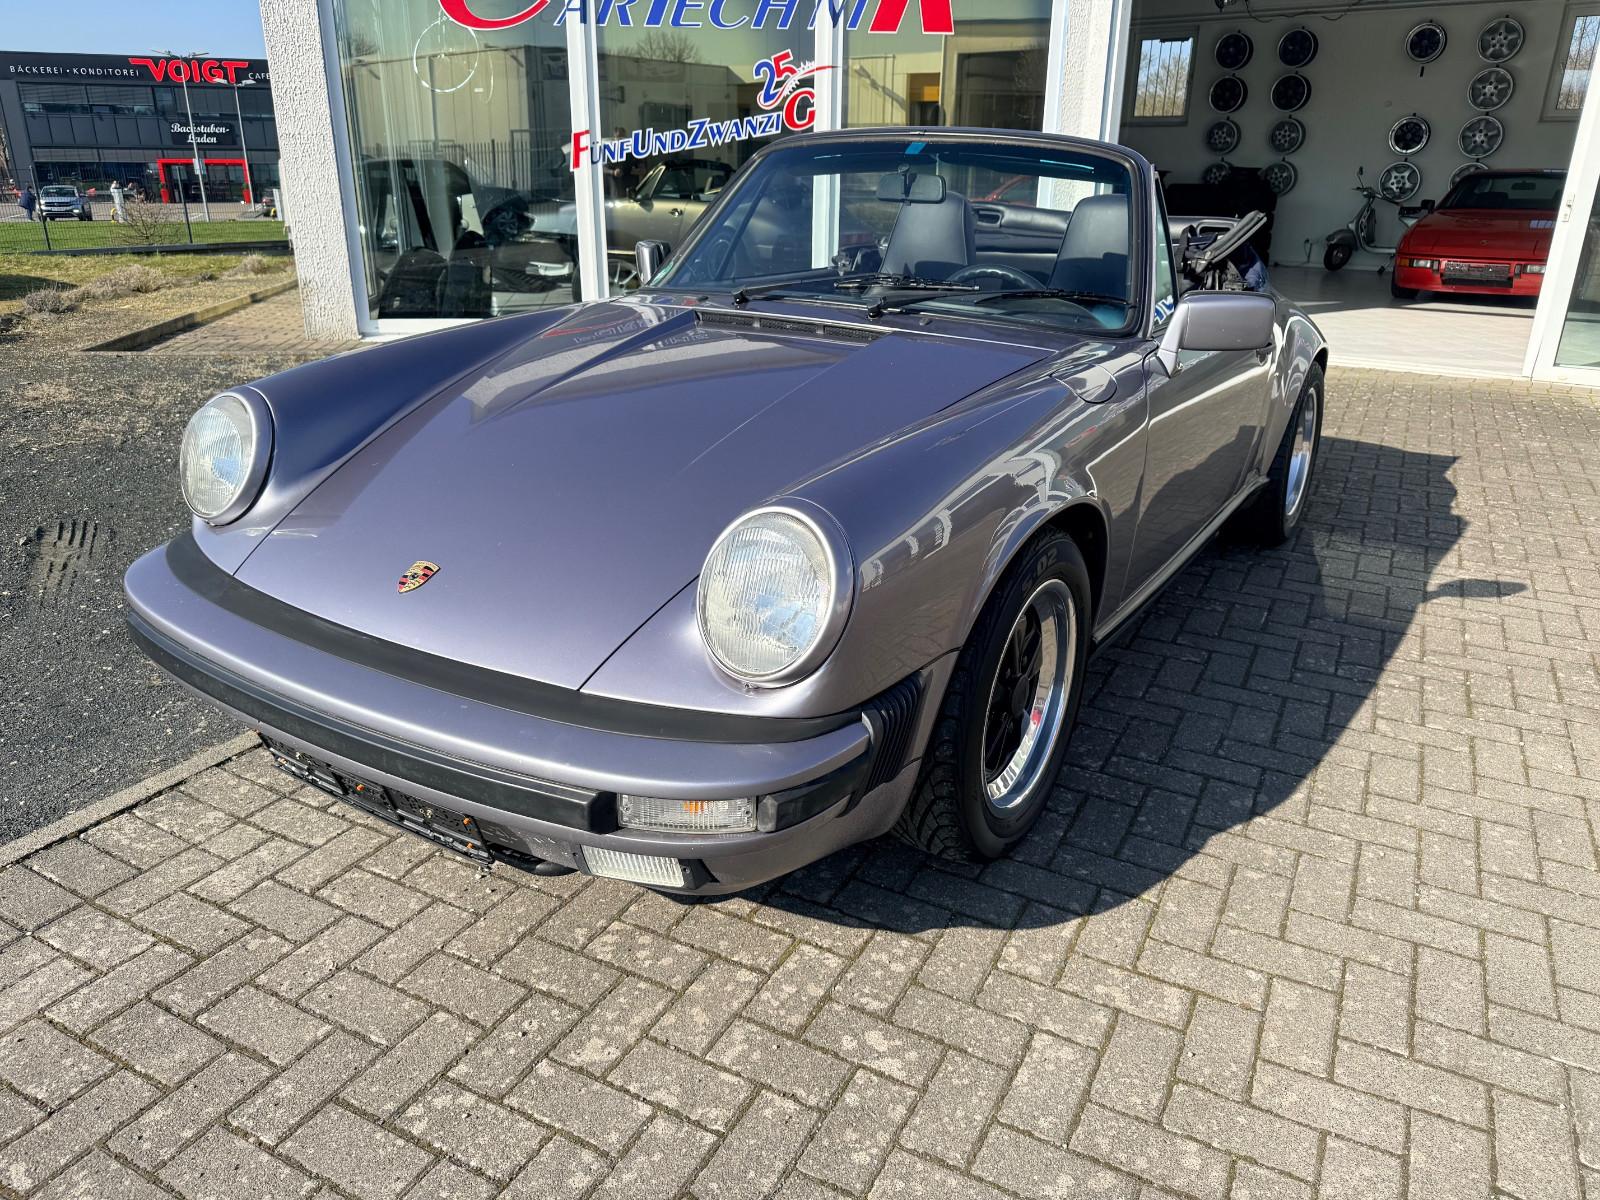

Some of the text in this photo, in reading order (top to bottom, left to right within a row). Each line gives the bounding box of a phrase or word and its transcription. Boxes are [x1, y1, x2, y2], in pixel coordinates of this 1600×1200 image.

[9, 65, 63, 75] BÄCKEREI
[72, 67, 140, 77] KONDITOREI
[128, 57, 249, 83] VOIGT
[753, 50, 799, 107] 25
